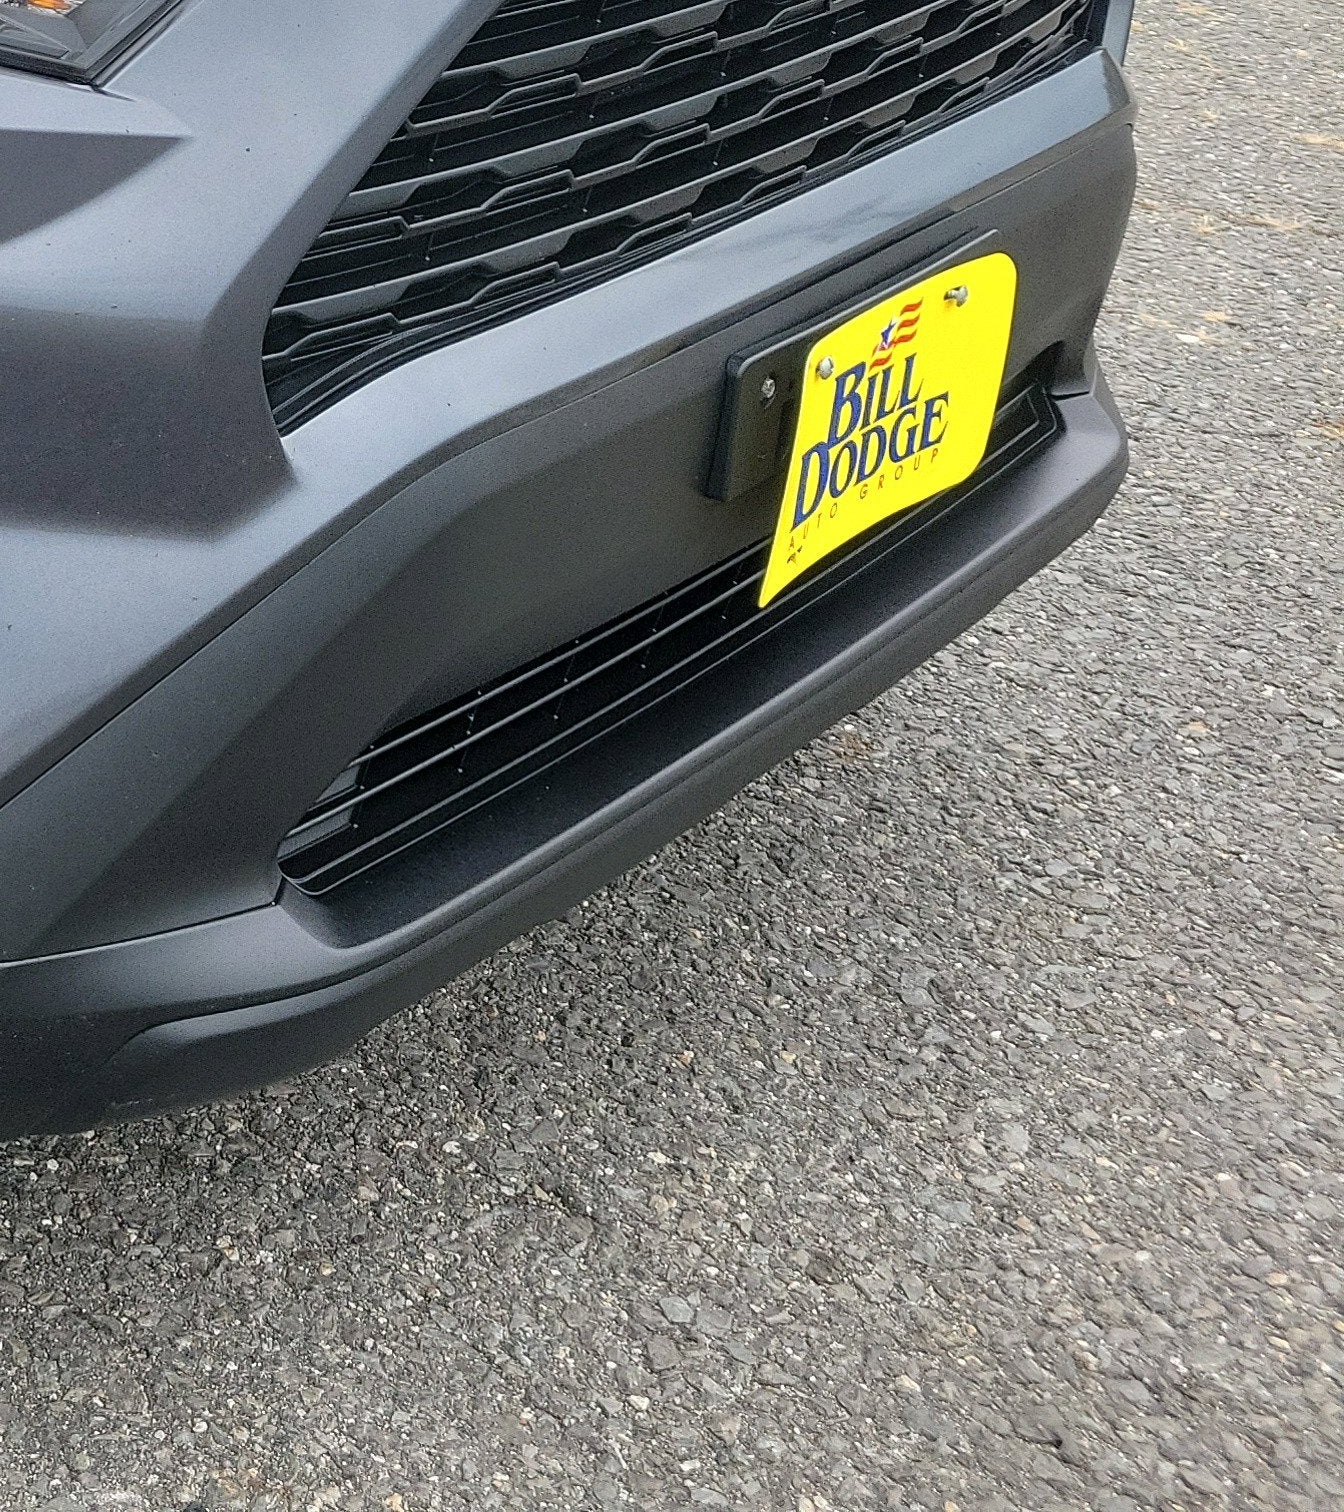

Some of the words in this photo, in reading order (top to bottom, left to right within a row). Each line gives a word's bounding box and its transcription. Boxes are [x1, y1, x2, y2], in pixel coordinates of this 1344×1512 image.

[826, 352, 926, 448] BILL
[788, 502, 838, 551] AUTO
[859, 447, 939, 500] GROUP
[790, 391, 950, 533] DODGE
